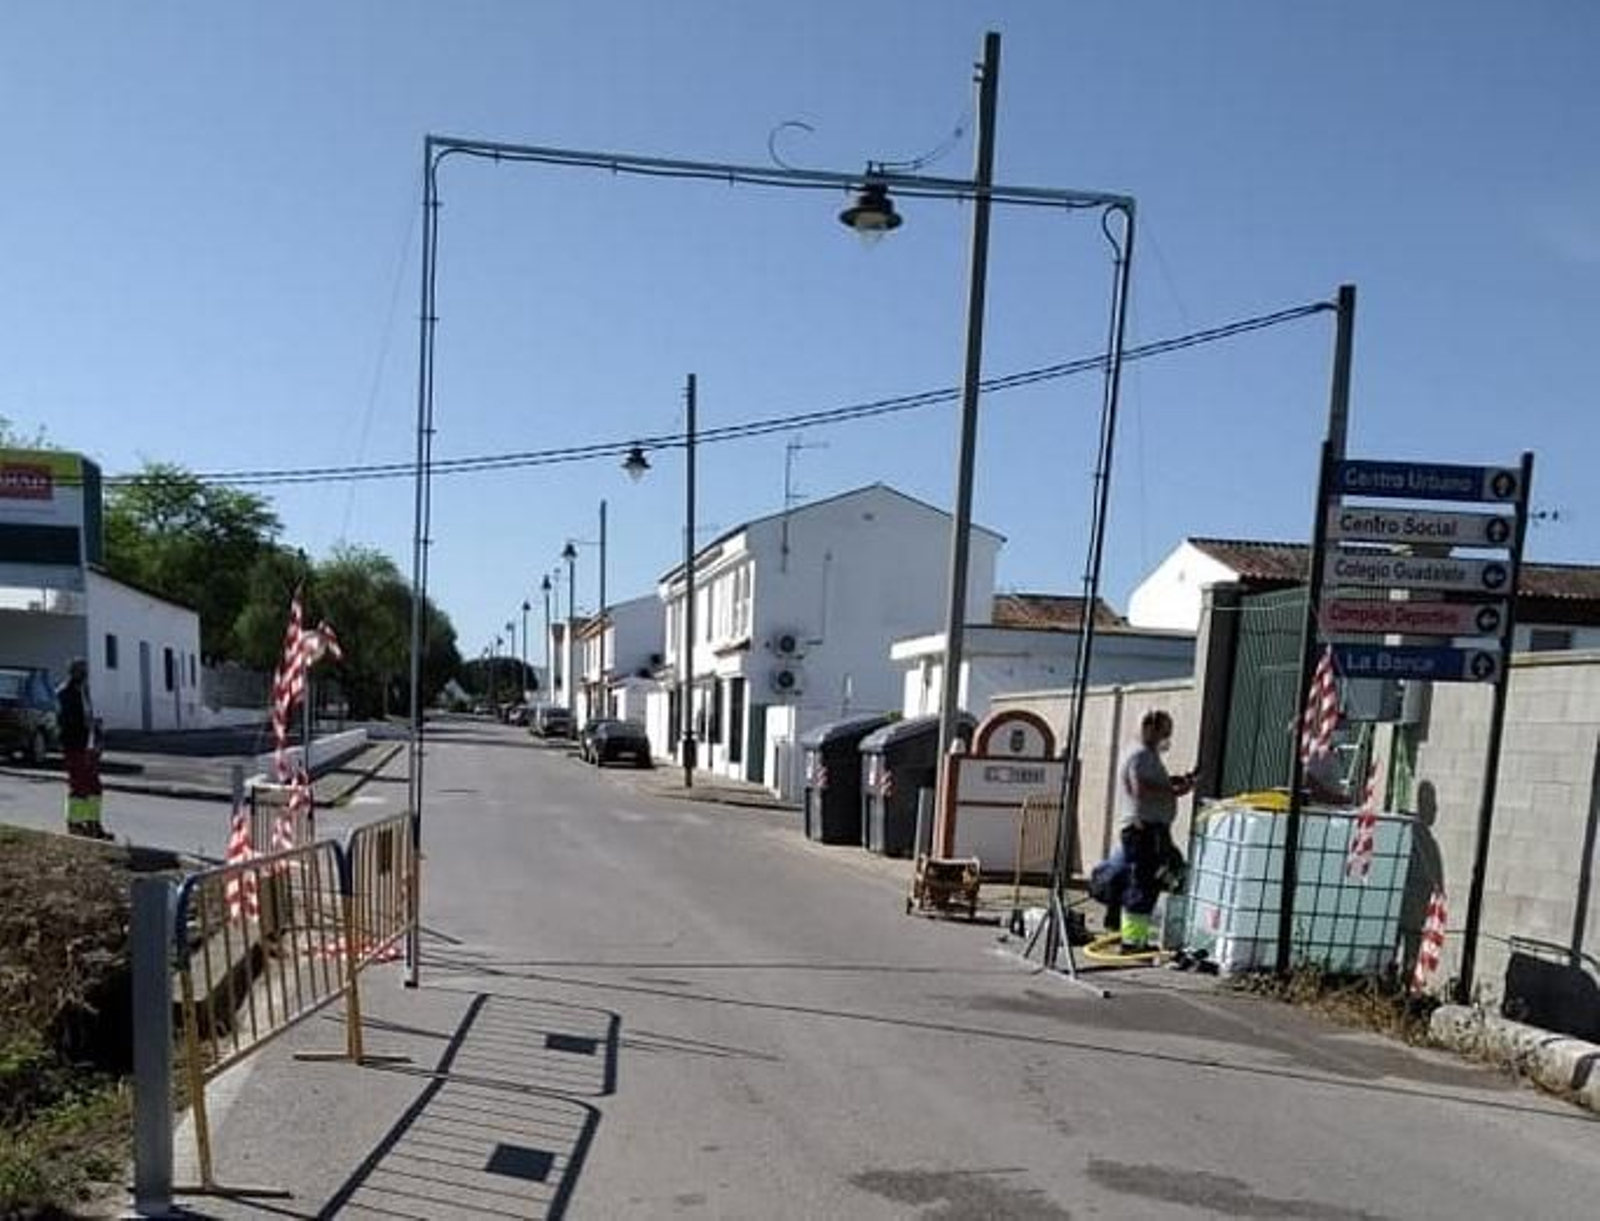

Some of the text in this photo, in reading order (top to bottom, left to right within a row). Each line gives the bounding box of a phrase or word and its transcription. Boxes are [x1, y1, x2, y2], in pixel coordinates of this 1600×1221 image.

[1346, 466, 1474, 492] Centro Urbano
[1340, 514, 1458, 536] Centro Social
[1335, 560, 1390, 582] Colegio
[1346, 652, 1371, 670] La
